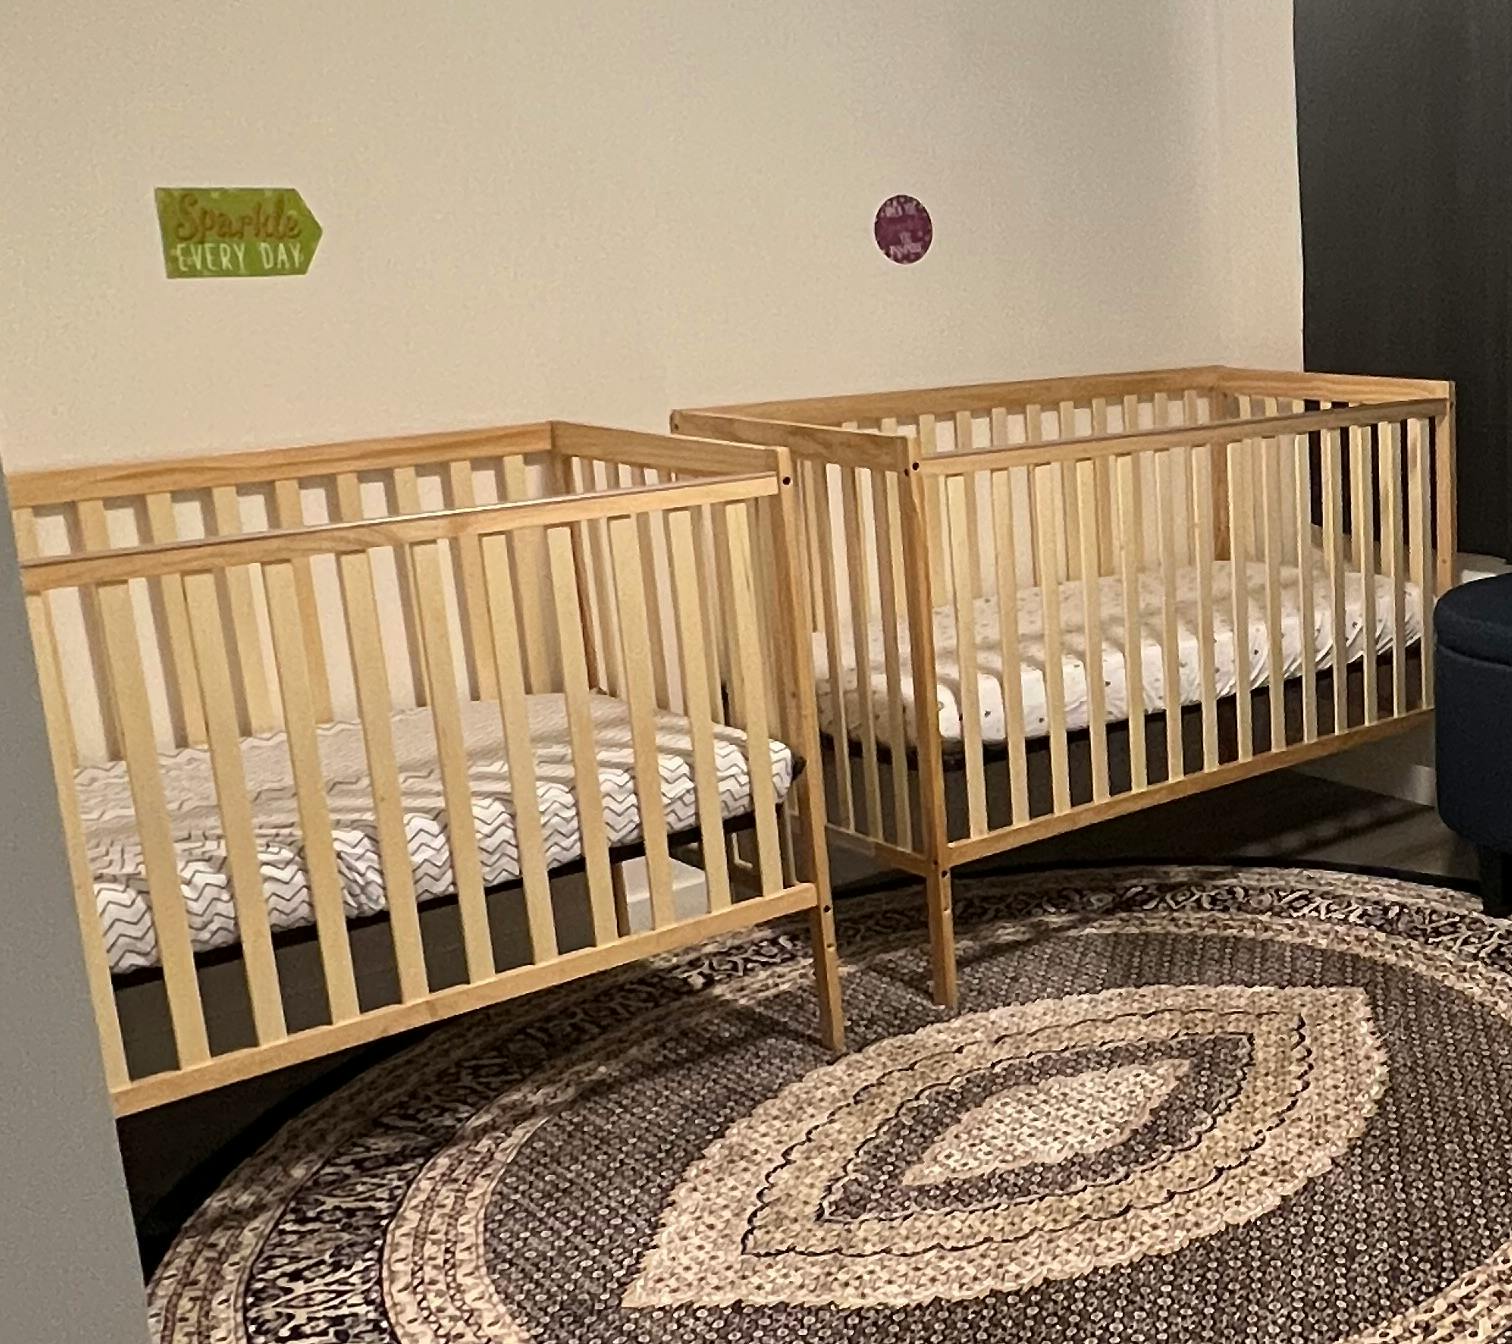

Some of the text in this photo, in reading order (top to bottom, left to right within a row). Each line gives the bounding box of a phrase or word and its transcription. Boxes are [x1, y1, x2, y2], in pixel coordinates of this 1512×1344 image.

[175, 193, 301, 243] Sparkle
[176, 242, 303, 273] EVERY DAY
